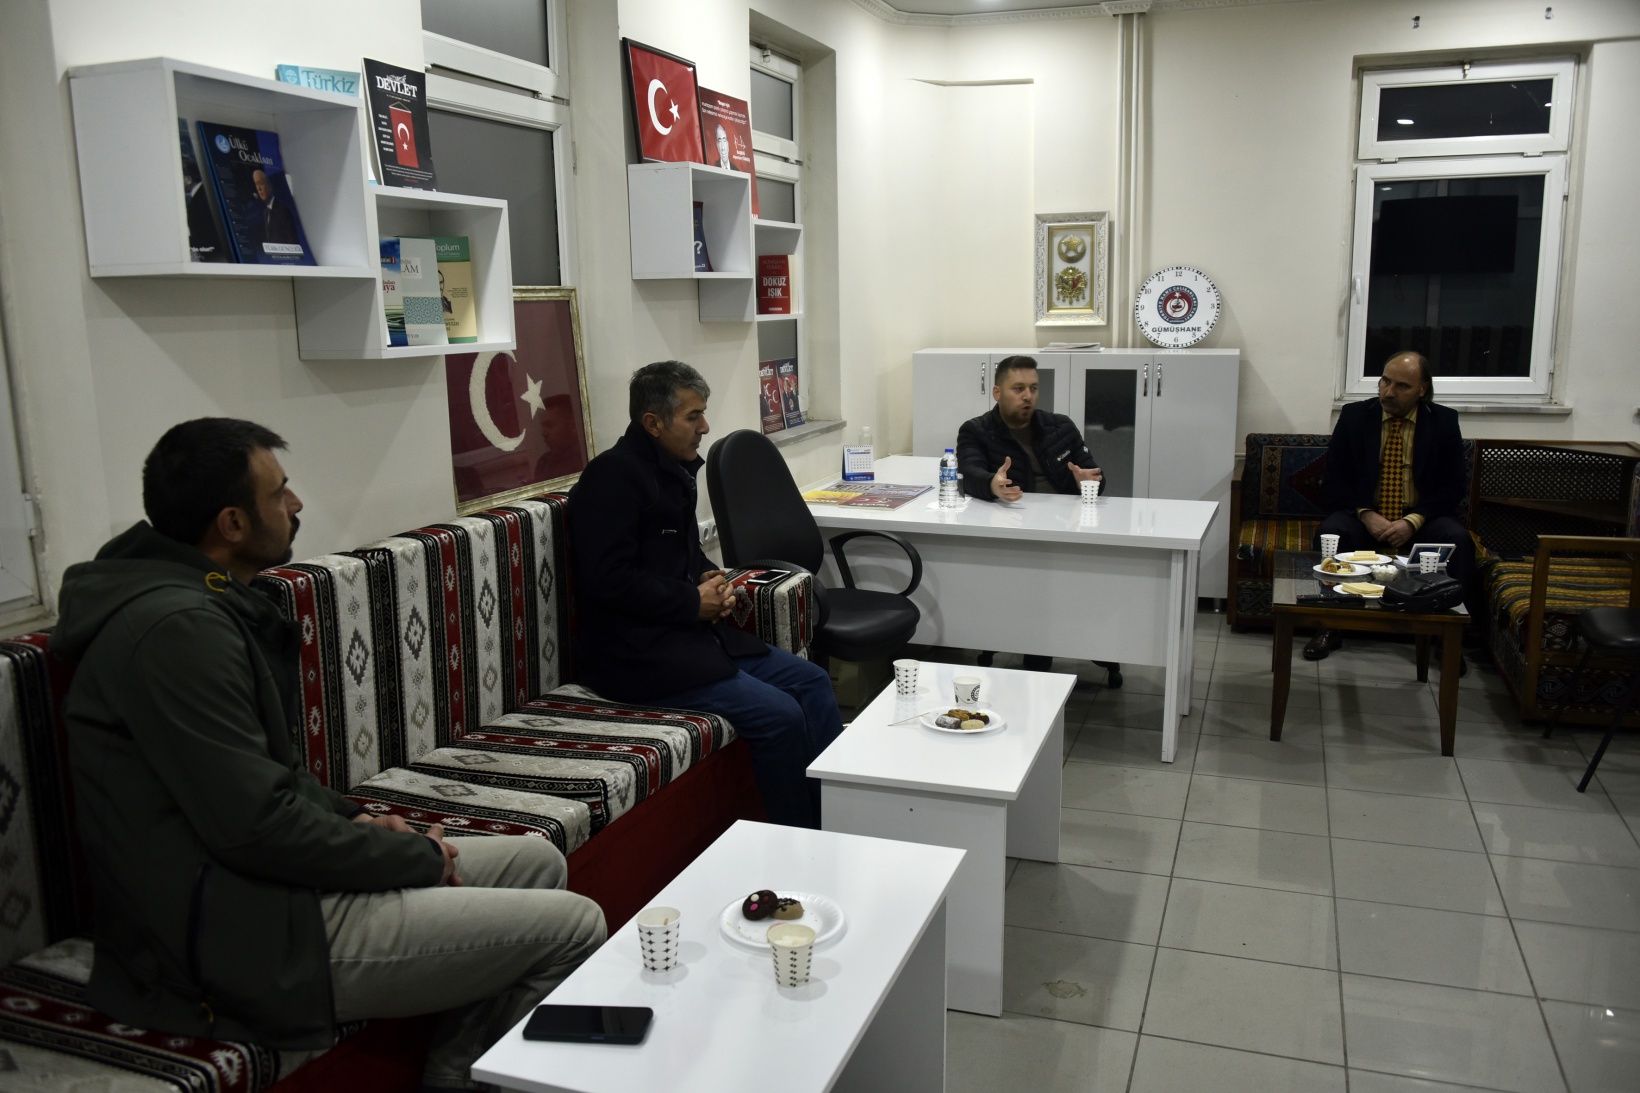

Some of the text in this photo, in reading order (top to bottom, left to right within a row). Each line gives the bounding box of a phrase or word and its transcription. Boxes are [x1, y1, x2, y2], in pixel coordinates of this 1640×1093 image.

[302, 70, 355, 94] Türkiz
[375, 75, 418, 98] DEVLET
[228, 134, 249, 151] Ülkü
[762, 277, 787, 286] DOKUZ
[767, 287, 782, 298] IŞIK
[1151, 326, 1202, 334] GÜMÜŞHANE
